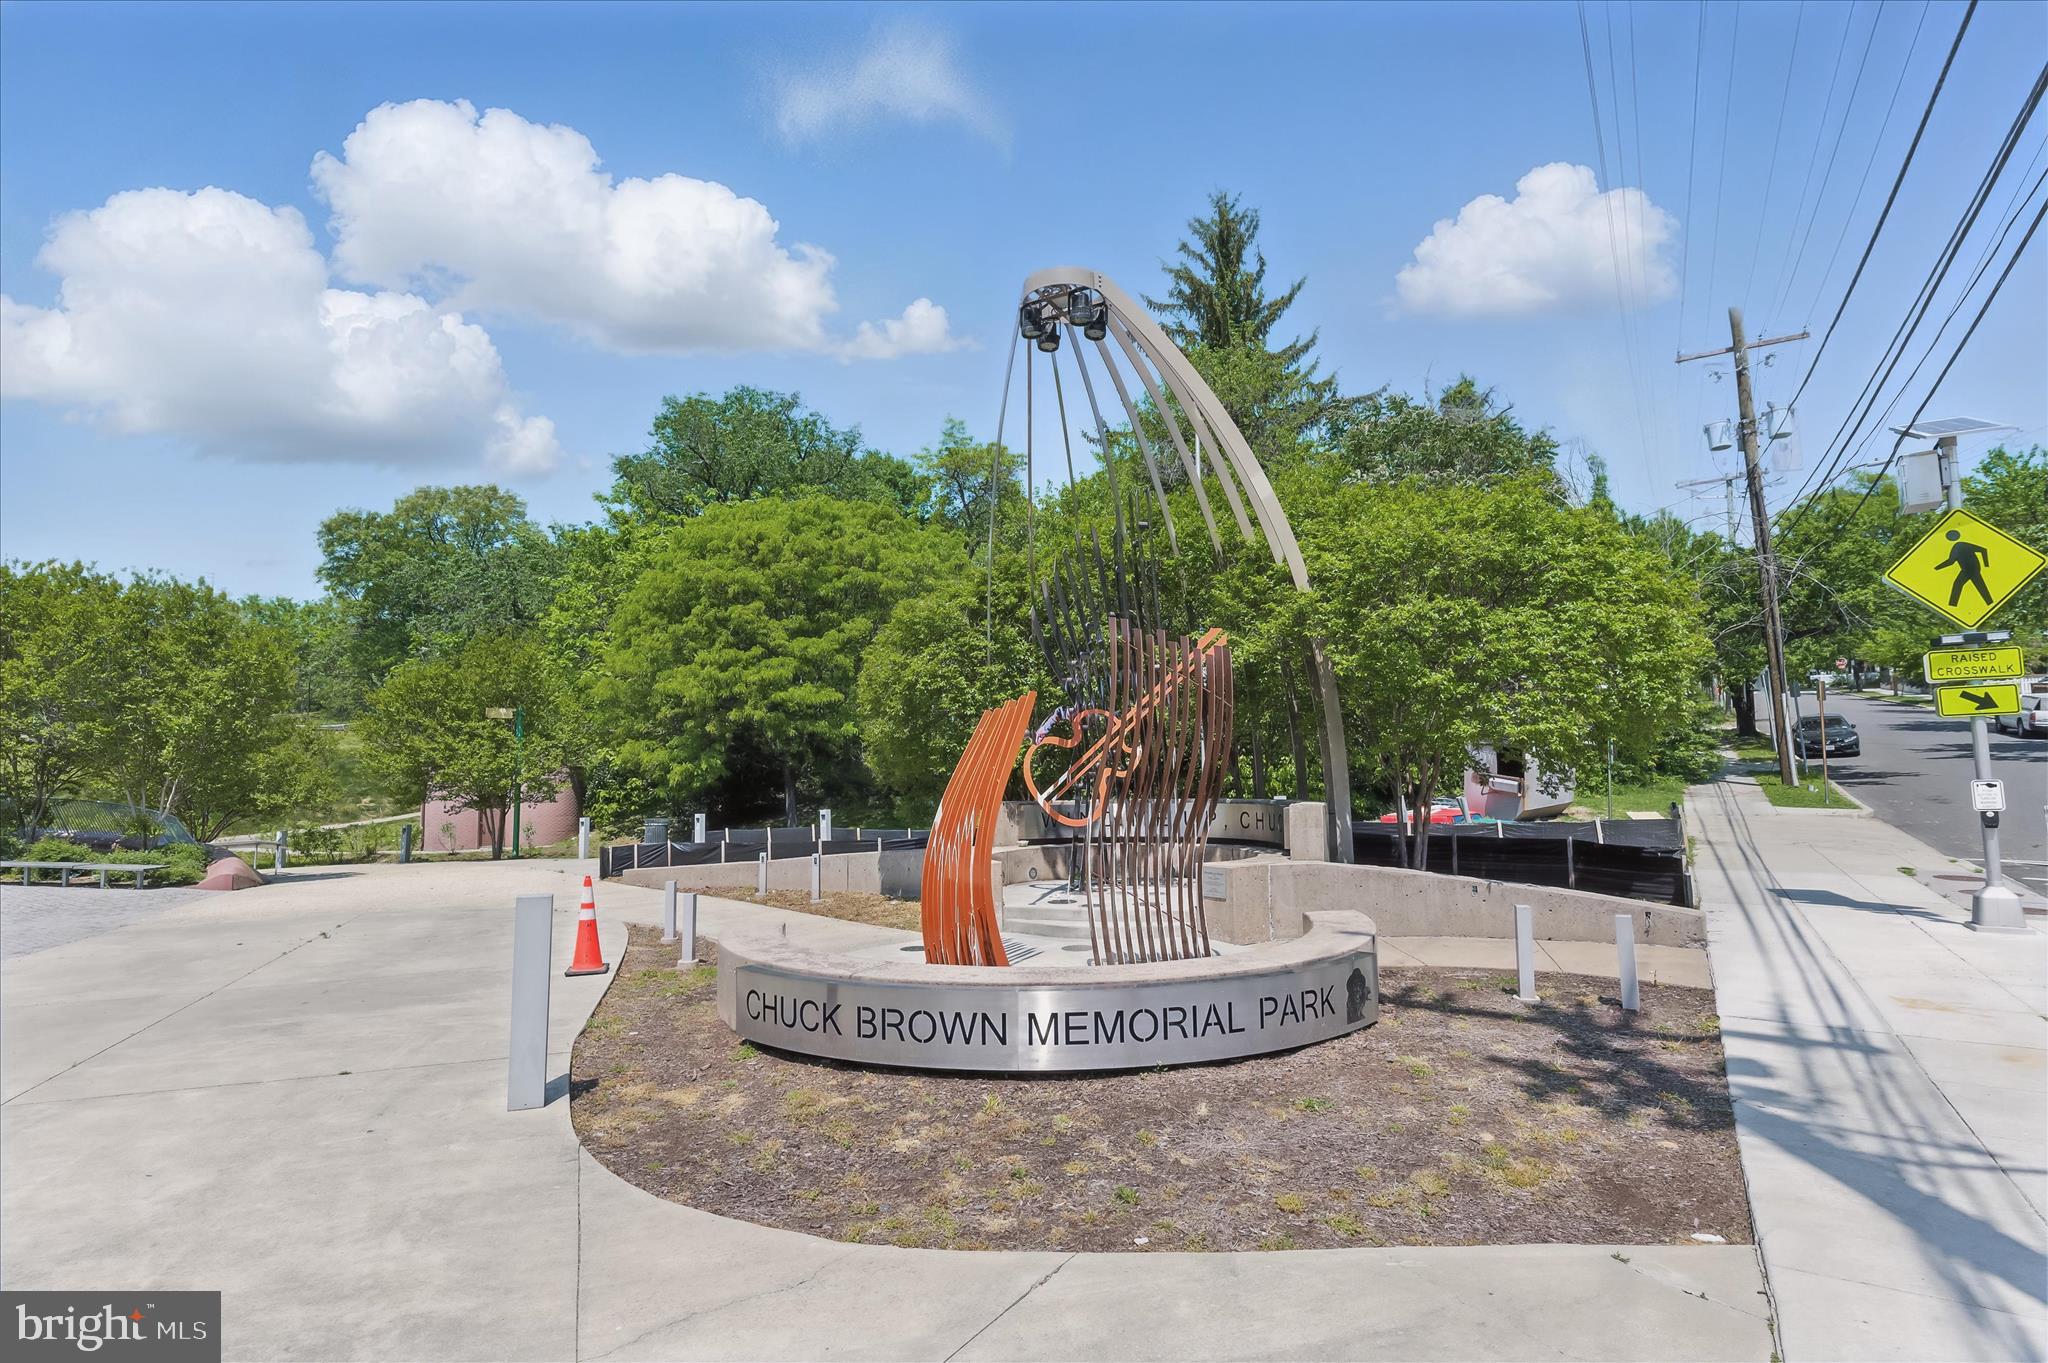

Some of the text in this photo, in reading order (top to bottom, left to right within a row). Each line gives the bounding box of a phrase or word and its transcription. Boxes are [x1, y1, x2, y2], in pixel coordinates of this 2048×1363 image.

[1951, 652, 1997, 663] RAISED
[1937, 664, 2015, 677] CROSSWALK
[746, 984, 1335, 1046] CHUCK BROWN MEMORIAL PARK
